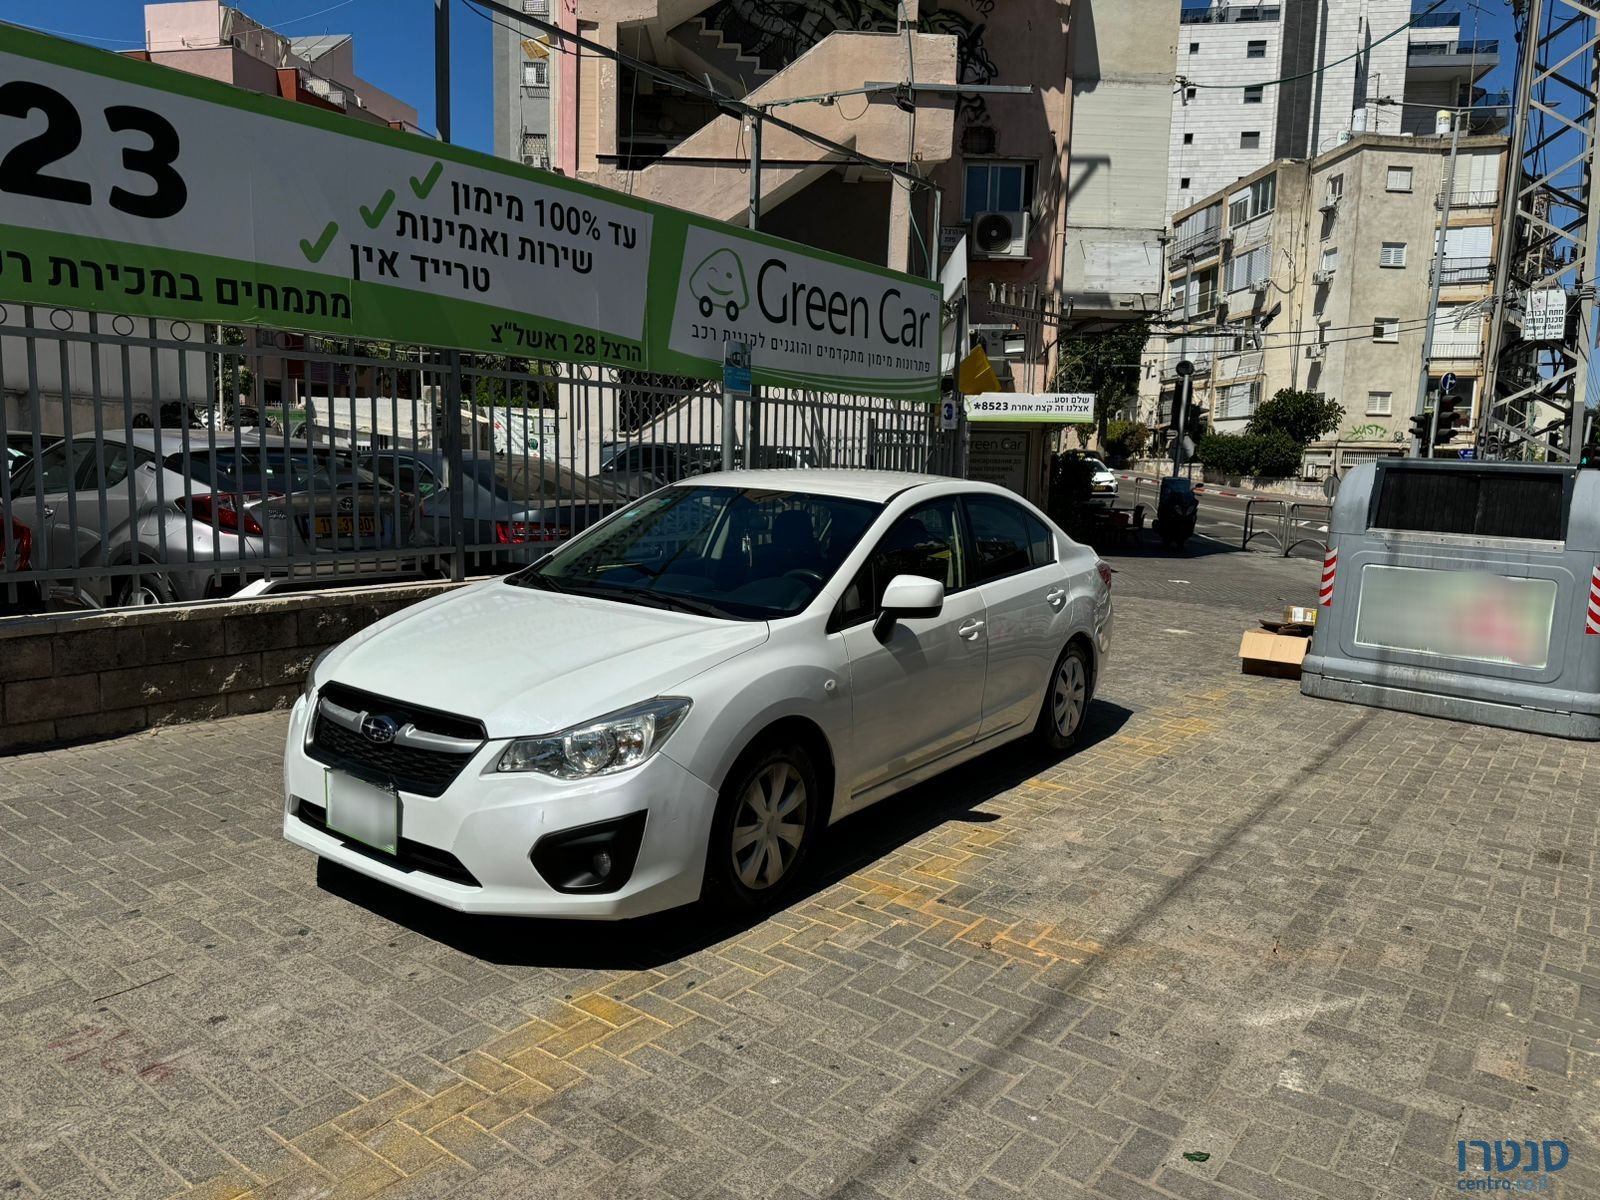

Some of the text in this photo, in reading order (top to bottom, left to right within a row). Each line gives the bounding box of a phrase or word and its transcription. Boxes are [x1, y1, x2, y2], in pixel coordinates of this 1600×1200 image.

[452, 181, 637, 250] עד 100% מימון
[396, 210, 593, 274] שירות ואמינות
[350, 243, 490, 292] טרייד אין
[49, 254, 203, 302] במכירת
[216, 277, 352, 320] מתמחים
[757, 258, 931, 348] Green Car
[691, 323, 716, 340] רכב
[573, 333, 596, 356] 28
[601, 337, 642, 363] הרצל
[771, 338, 812, 356] והוגנים
[816, 344, 865, 364] מתקדמים
[868, 354, 893, 368] מימון
[895, 358, 931, 373] פתרונות
[1011, 404, 1033, 412] אחרת
[1035, 404, 1053, 414] קצת
[1054, 404, 1064, 412] זה
[1066, 404, 1090, 412] אצלנו
[1071, 396, 1090, 404] שלם
